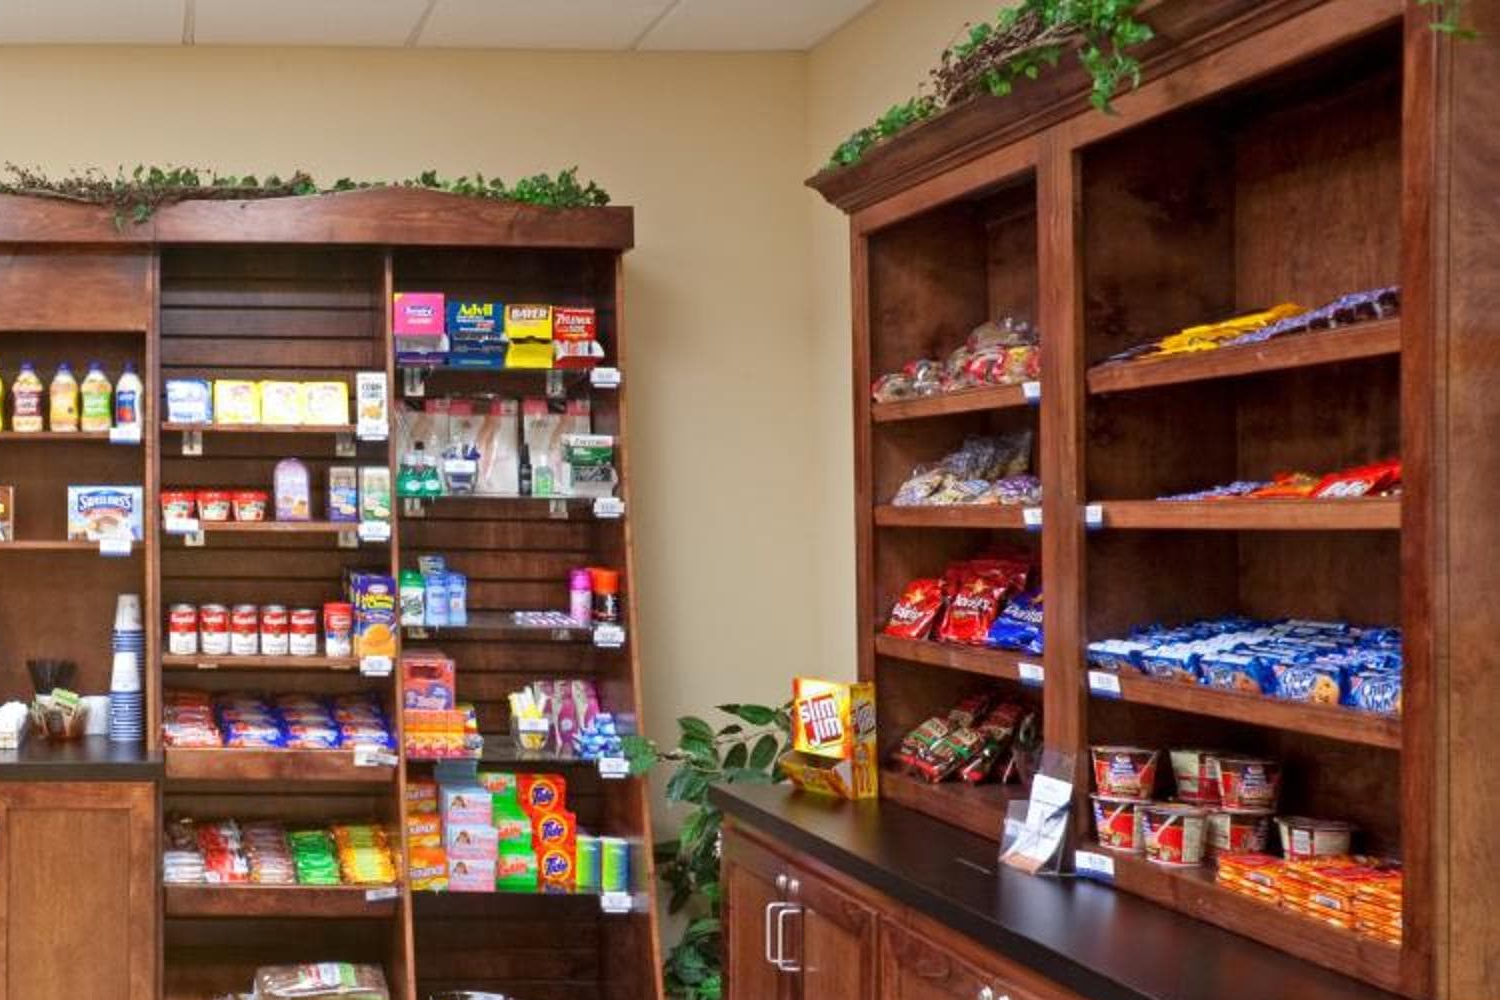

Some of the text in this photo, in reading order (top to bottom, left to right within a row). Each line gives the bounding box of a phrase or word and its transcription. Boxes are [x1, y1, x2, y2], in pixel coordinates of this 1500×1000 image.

[458, 303, 493, 317] Advil
[532, 785, 556, 807] Tide
[541, 819, 566, 841] Tide
[545, 854, 569, 876] Tide
